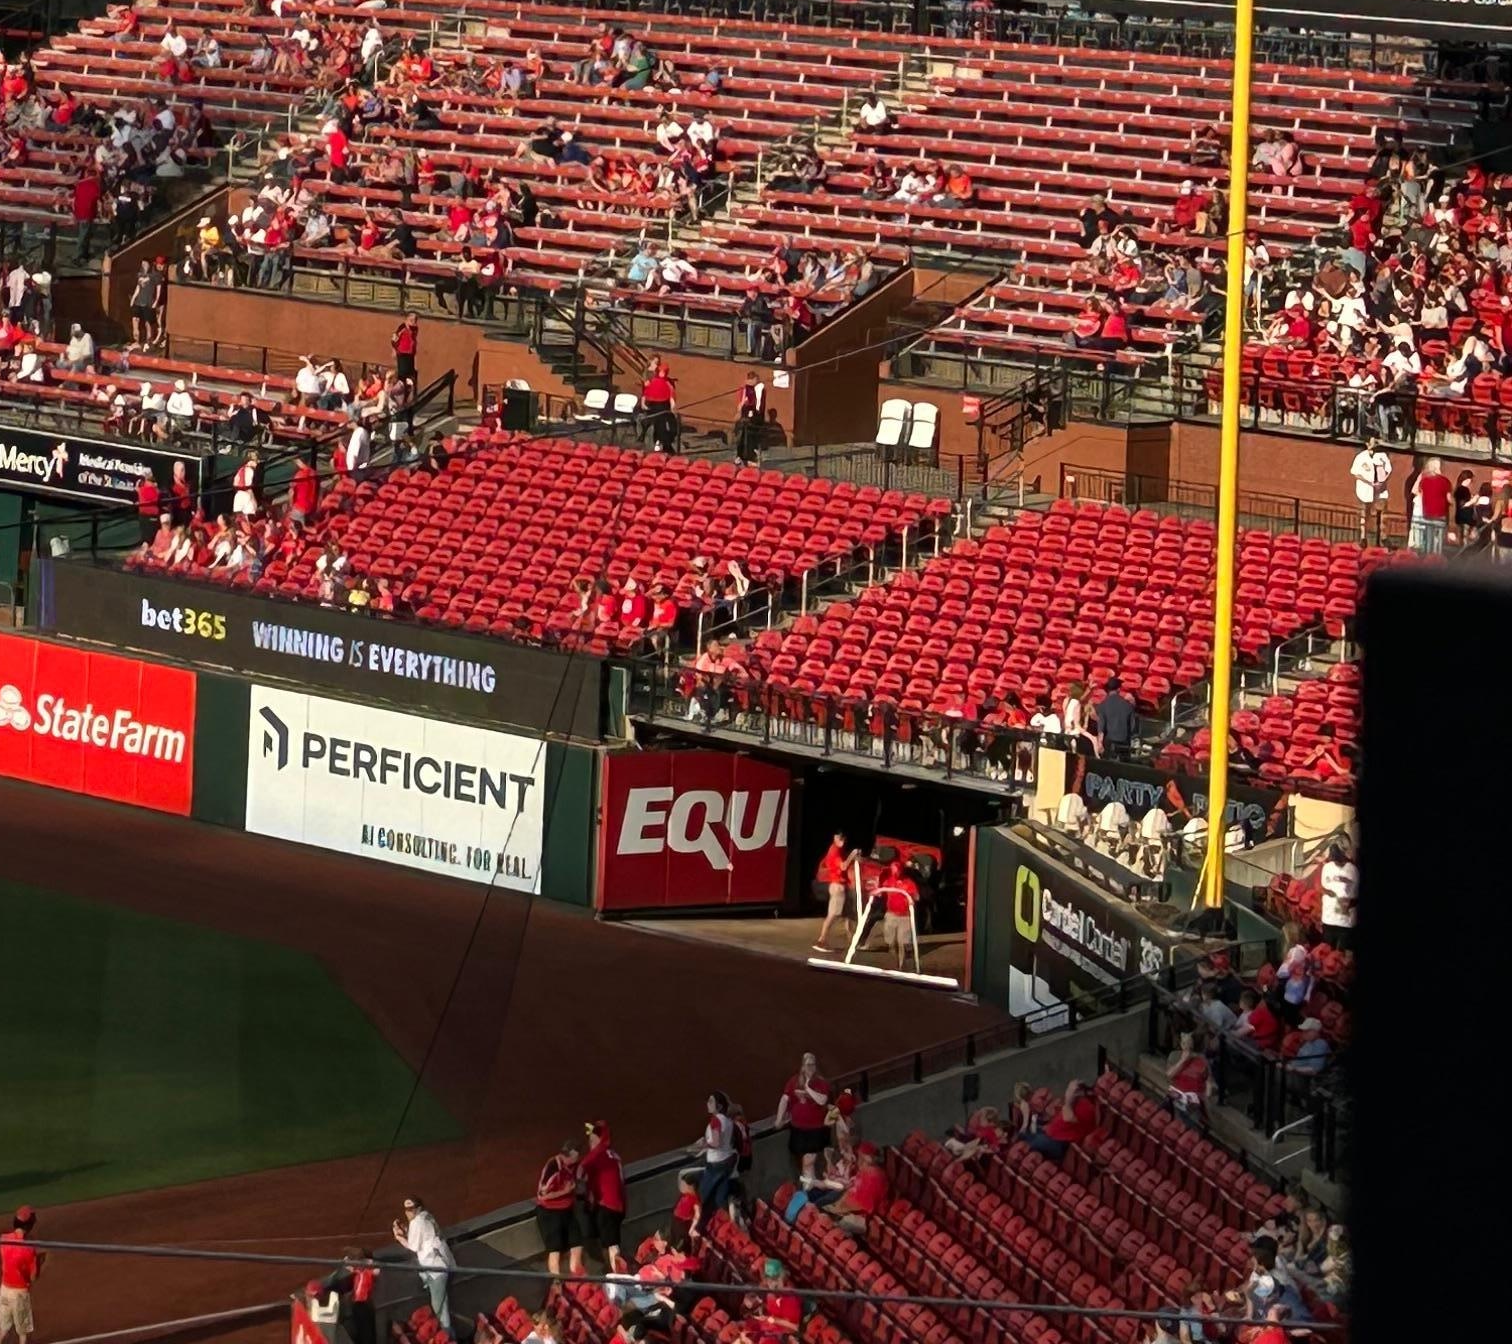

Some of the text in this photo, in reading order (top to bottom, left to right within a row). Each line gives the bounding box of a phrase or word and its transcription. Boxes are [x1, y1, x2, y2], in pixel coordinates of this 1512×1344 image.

[140, 597, 497, 695] bet365 WINNING IS EVERYTHING
[301, 731, 536, 814] PERFICIENT
[1084, 771, 1165, 808] PARTY
[360, 823, 376, 847] AI
[466, 845, 493, 873] FOR
